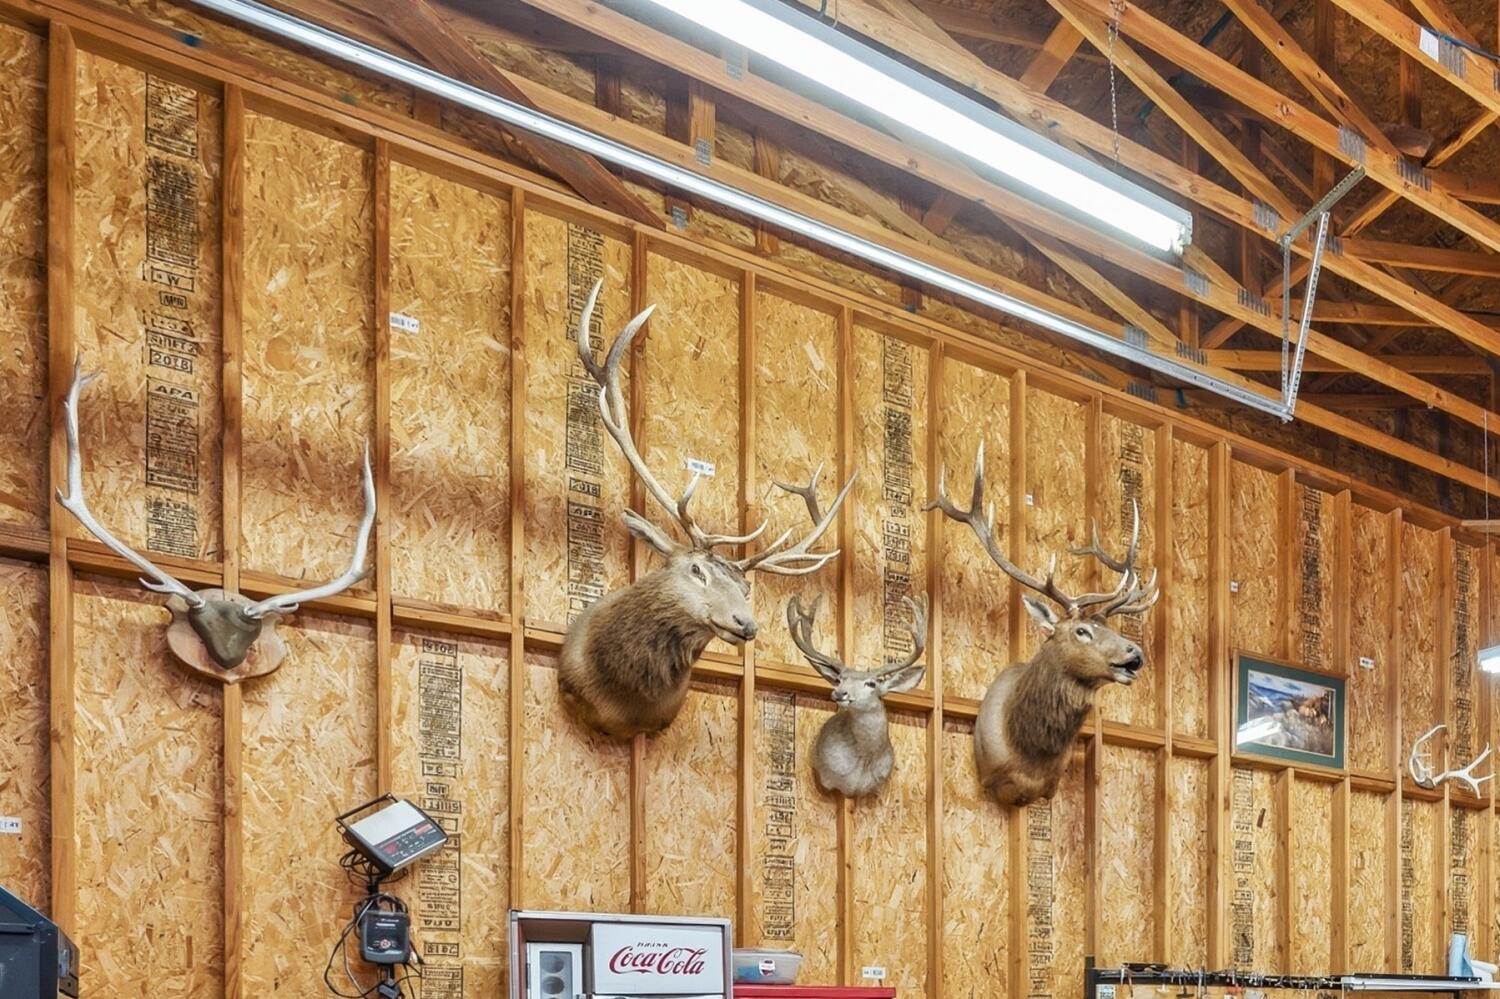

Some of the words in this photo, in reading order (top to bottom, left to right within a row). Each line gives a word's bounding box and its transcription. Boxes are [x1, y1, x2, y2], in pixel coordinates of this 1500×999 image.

[152, 352, 190, 371] 2018
[155, 384, 194, 400] APA
[609, 946, 708, 975] Coca-Cola
